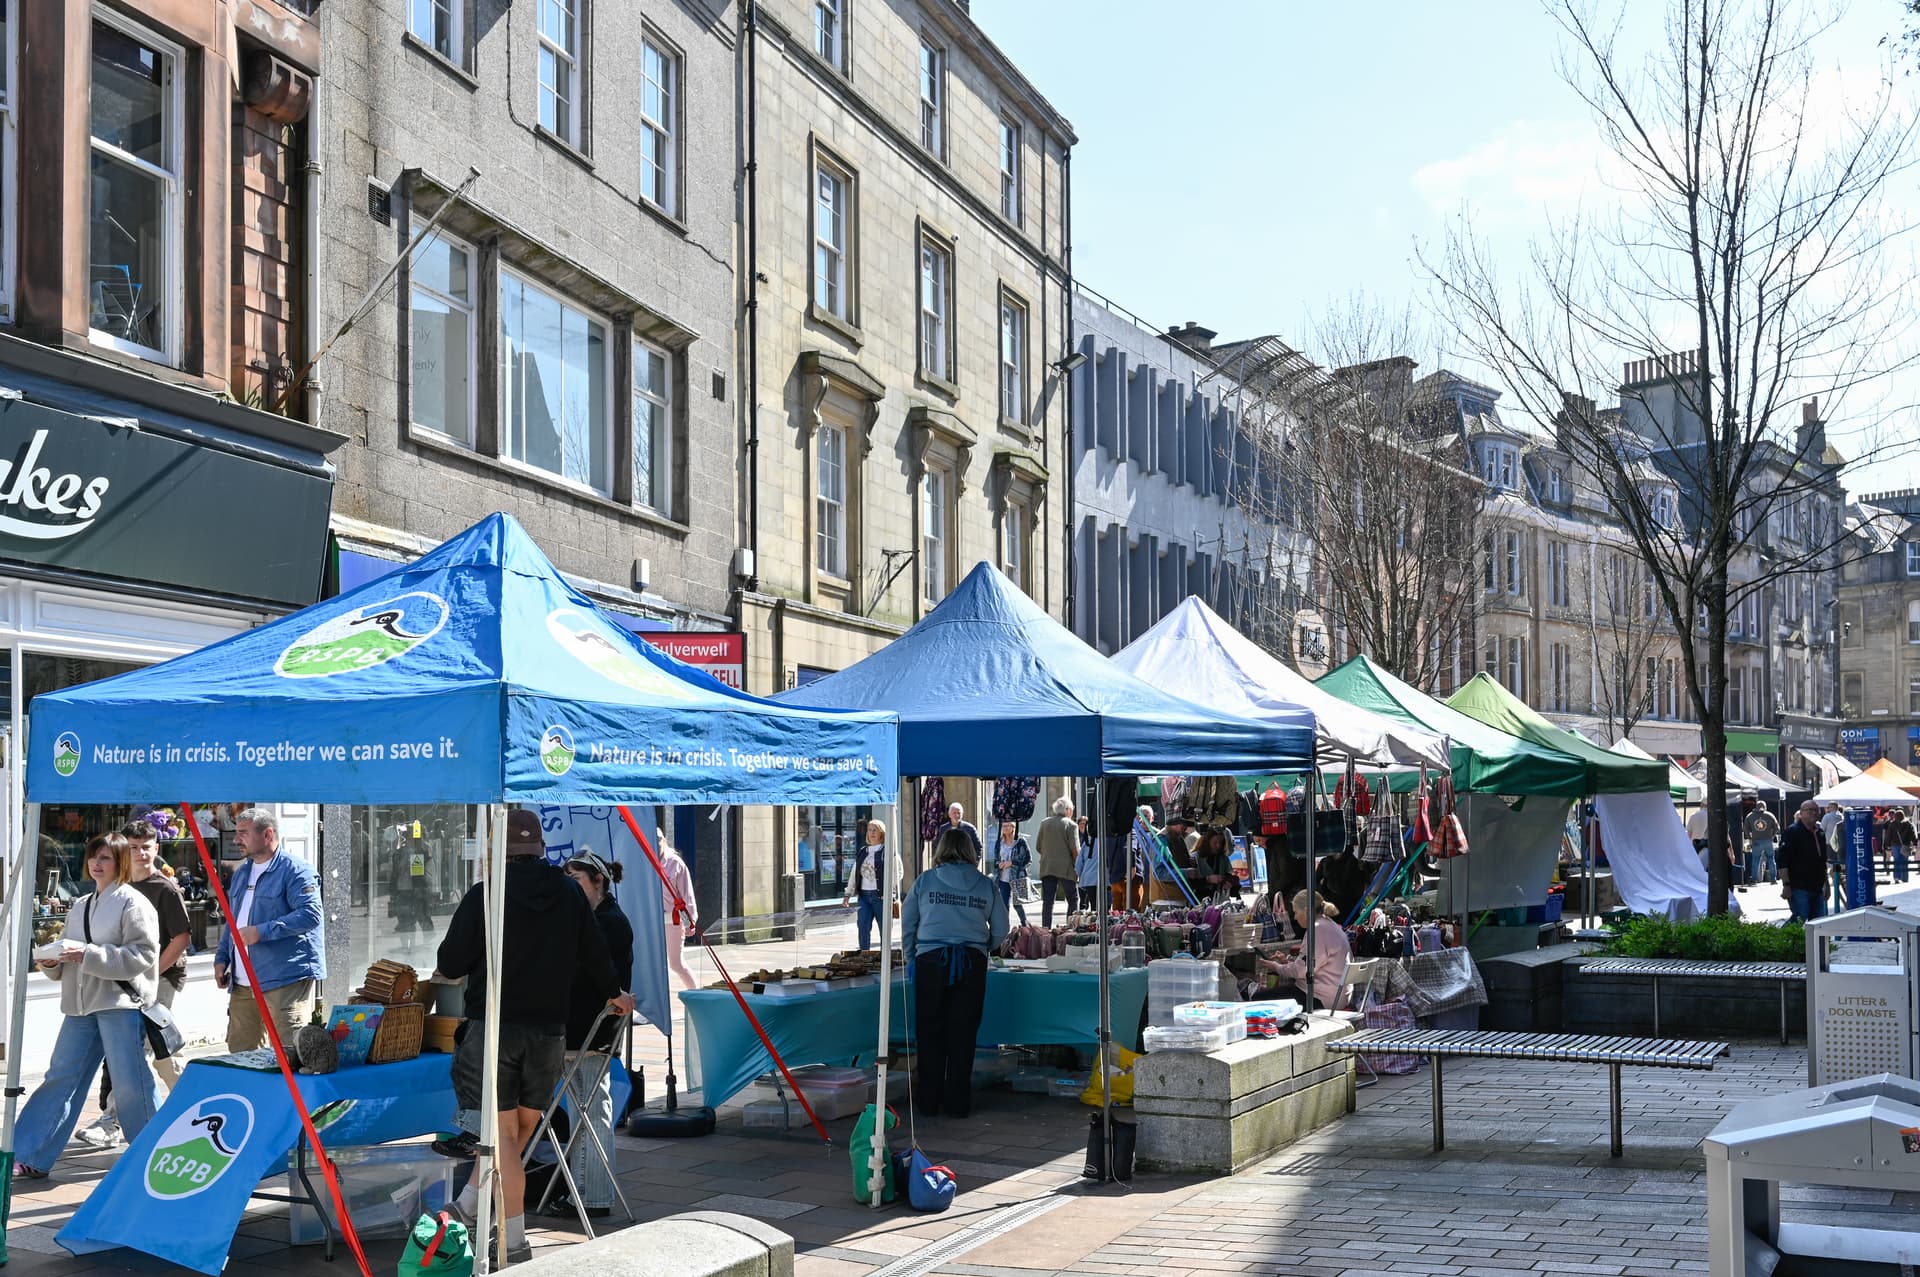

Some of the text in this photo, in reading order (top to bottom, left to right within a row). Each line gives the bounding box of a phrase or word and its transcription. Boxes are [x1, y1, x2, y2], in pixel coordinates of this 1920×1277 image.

[291, 647, 385, 664] RSPB
[93, 736, 459, 767] Nature is in crisis. Together we can save it.
[590, 742, 878, 773] Nature is in crisis. Together we can save it.
[57, 758, 76, 769] RSPB
[546, 755, 569, 767] RSPB
[1853, 827, 1864, 845] life
[1838, 996, 1888, 1006] LITTER &
[1829, 1007, 1897, 1018] DOG WASTE
[153, 1152, 213, 1184] RSPB
